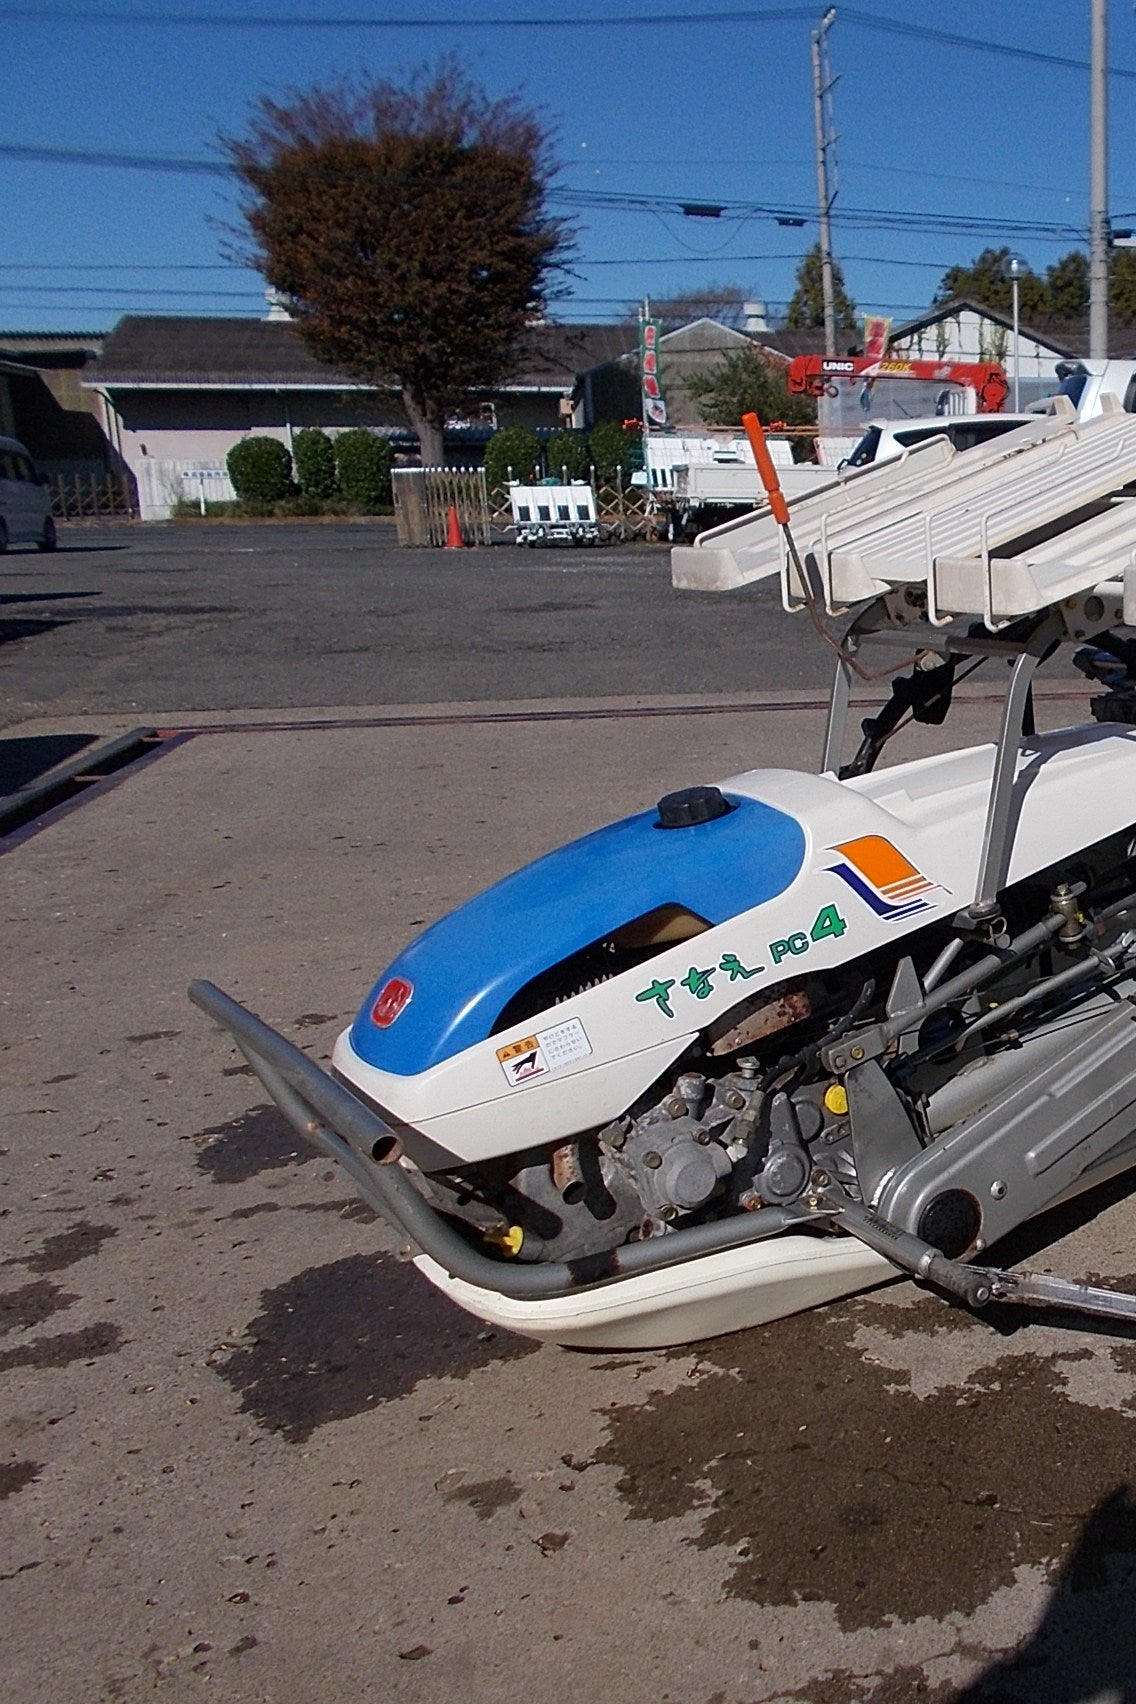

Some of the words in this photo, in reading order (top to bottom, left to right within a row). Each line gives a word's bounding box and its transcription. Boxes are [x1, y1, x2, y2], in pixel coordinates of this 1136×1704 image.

[822, 361, 854, 372] UNIC
[635, 953, 765, 1018] さなえ
